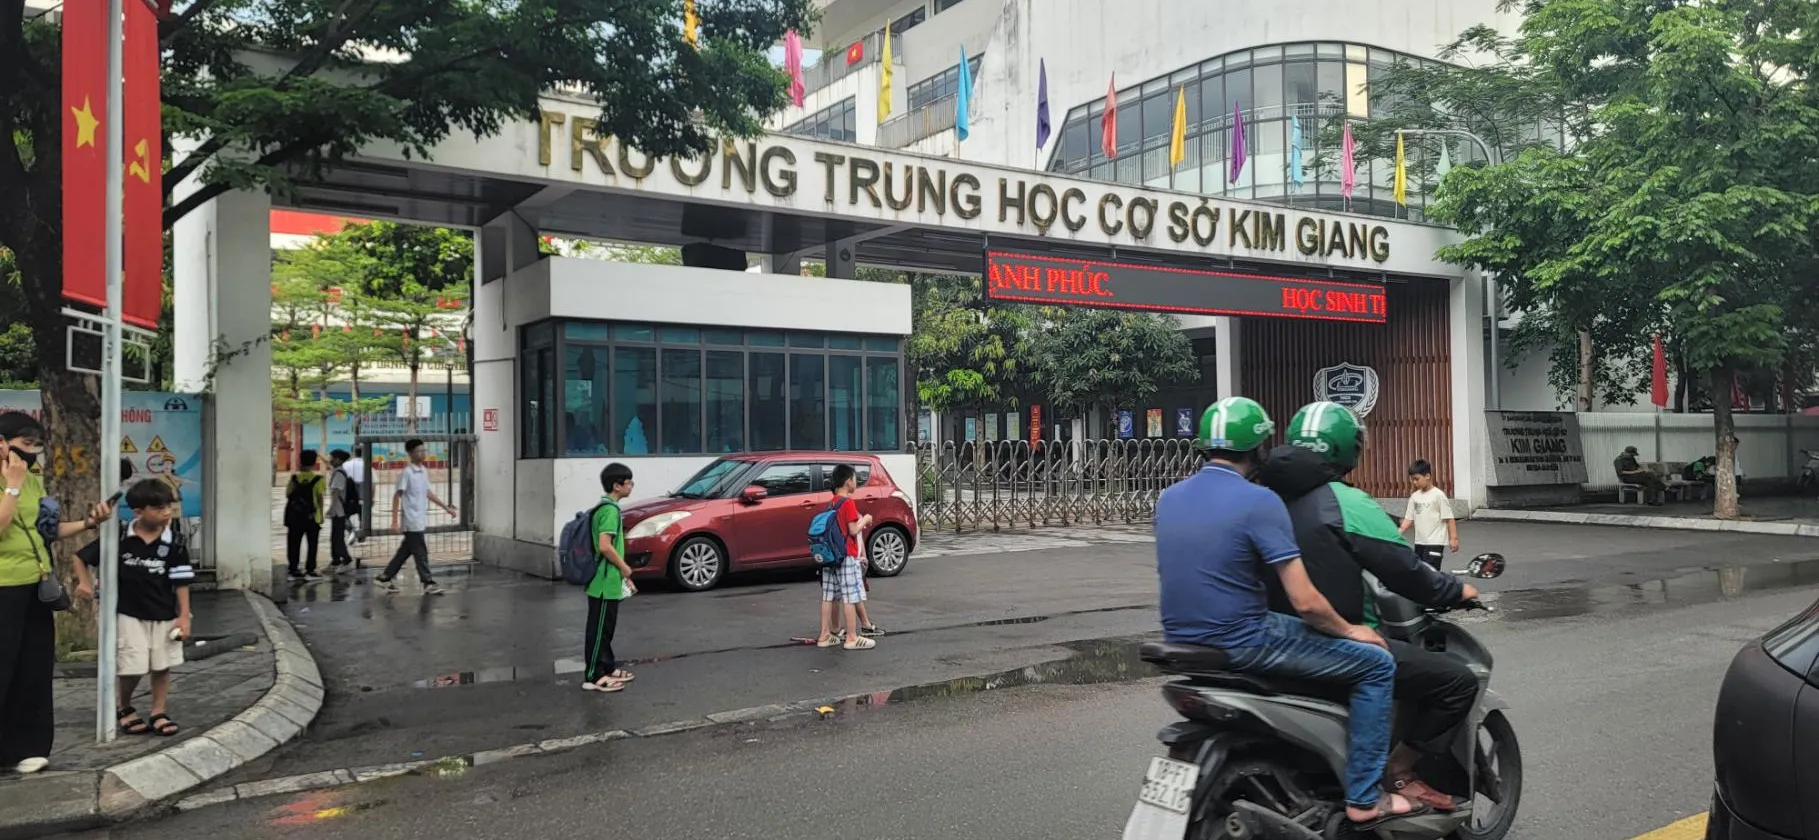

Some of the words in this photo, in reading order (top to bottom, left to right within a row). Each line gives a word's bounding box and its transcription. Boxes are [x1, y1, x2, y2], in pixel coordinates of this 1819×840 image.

[815, 152, 982, 220] TRUNG
[998, 177, 1087, 236] HỌC
[1098, 193, 1158, 239] CƠ
[1167, 199, 1220, 247] SỞ
[1229, 208, 1286, 252] KIM
[1296, 217, 1390, 263] GIANG
[1047, 264, 1114, 296] PHÚC.
[1281, 287, 1322, 313] HỌC
[1325, 290, 1368, 314] SINH
[121, 406, 152, 423] HÔNG
[1510, 438, 1531, 453] KIM
[1533, 438, 1567, 453] GIANG
